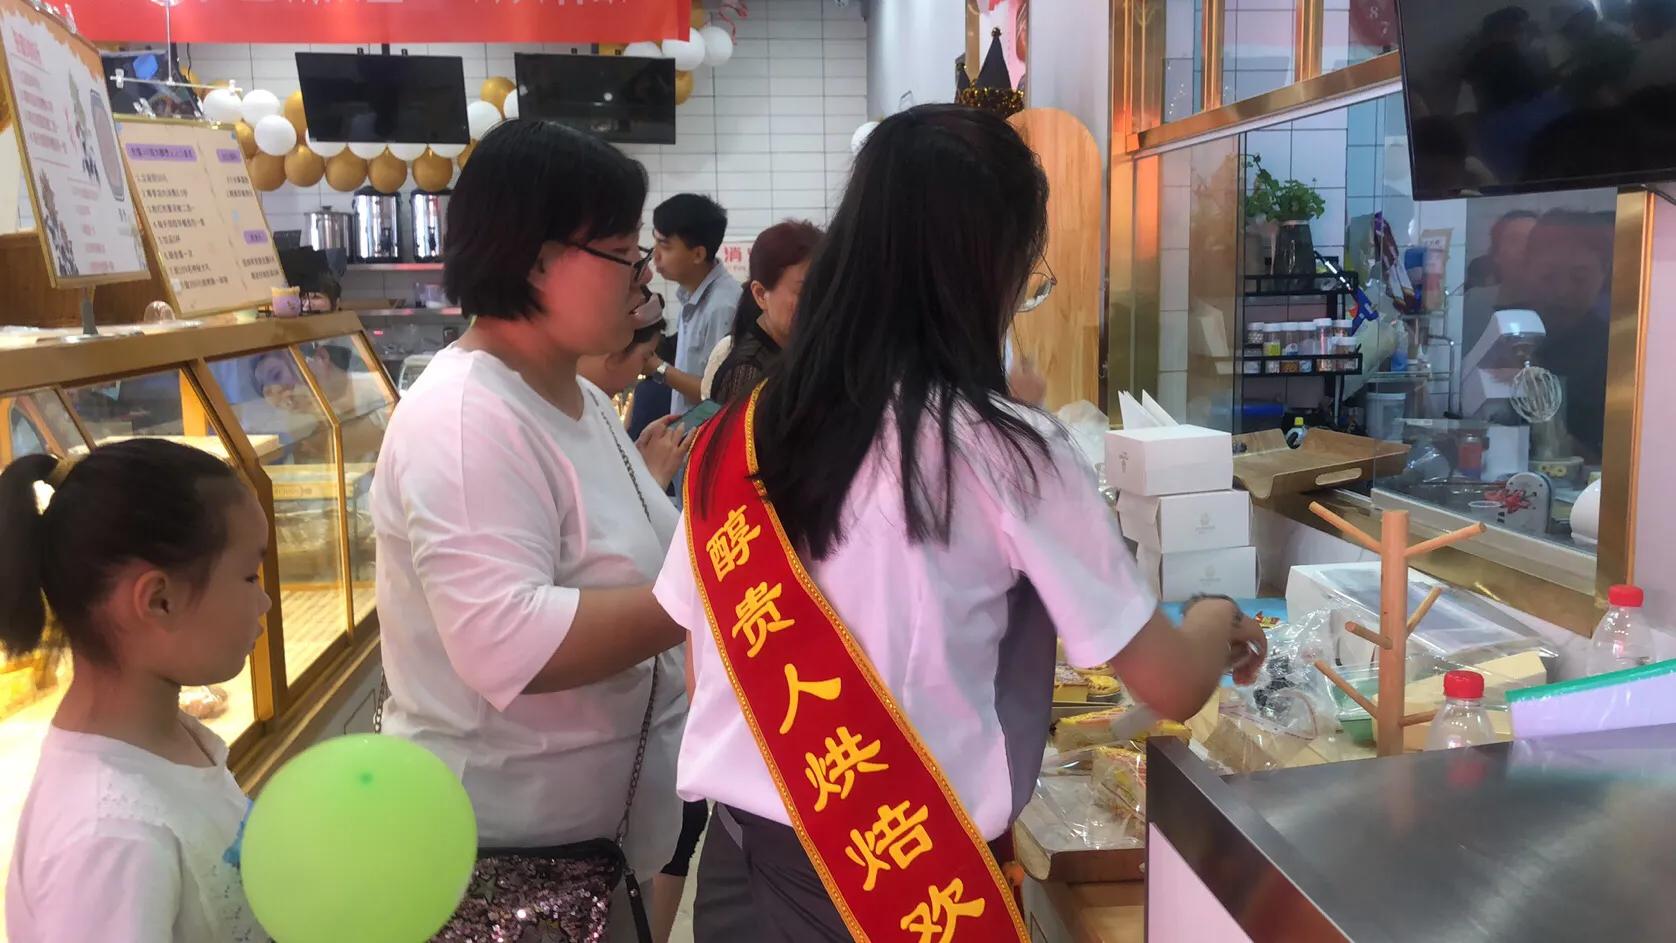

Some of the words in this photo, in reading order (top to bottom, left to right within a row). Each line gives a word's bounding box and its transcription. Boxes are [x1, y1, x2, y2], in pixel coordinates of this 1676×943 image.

[706, 505, 985, 943] 醇贵人烘焙欢
